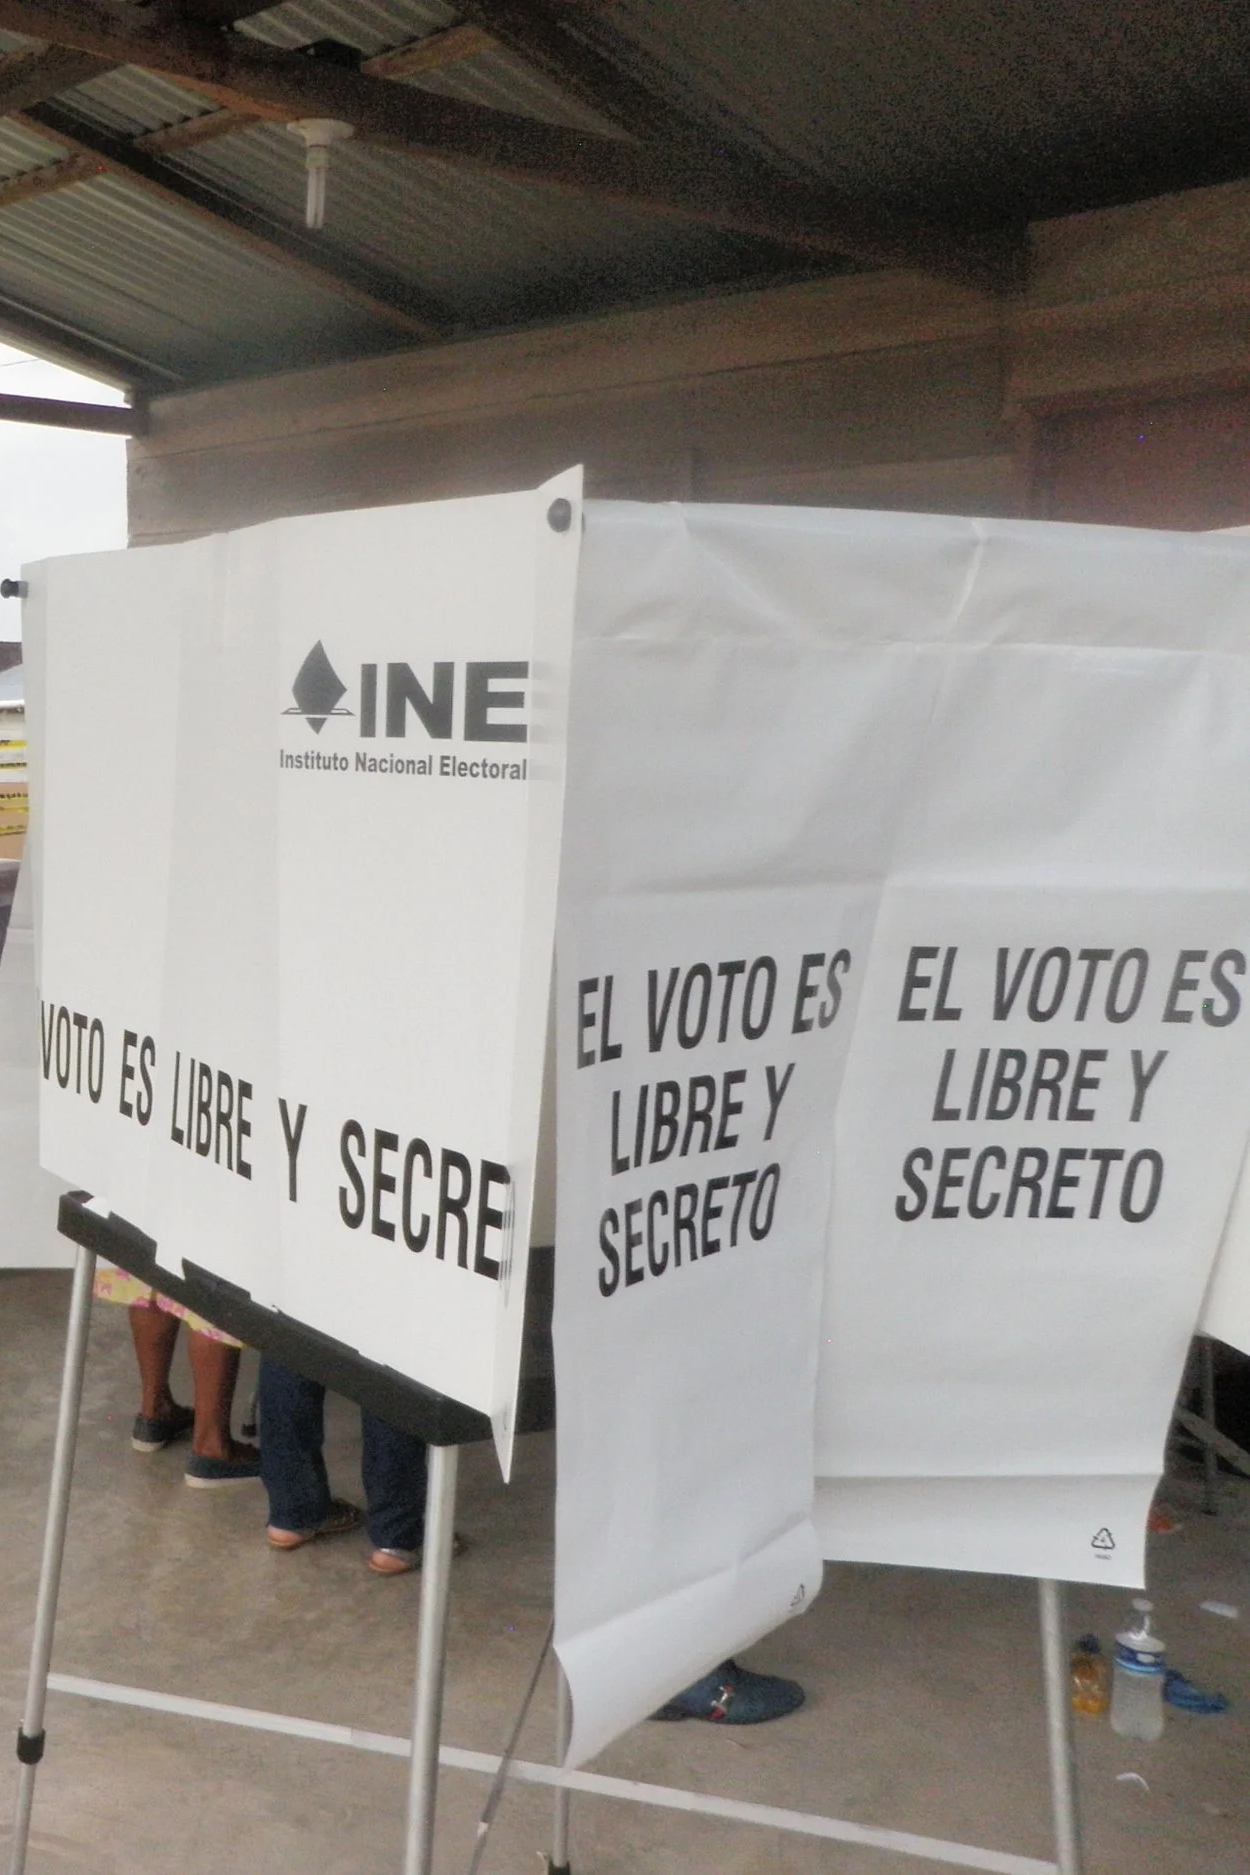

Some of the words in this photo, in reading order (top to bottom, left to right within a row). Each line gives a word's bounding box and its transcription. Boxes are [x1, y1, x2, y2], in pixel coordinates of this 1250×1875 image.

[360, 661, 529, 743] INE
[279, 749, 349, 771] Instituto
[355, 752, 432, 776] Nacional
[439, 755, 527, 780] Electoral
[577, 974, 623, 1070] EL
[647, 955, 778, 1053] VOTO
[791, 948, 851, 1034] ES
[897, 946, 963, 1022] EL
[992, 946, 1149, 1024] VOTO
[1161, 948, 1247, 1028] ES
[611, 1068, 747, 1177] LIBRE
[763, 1062, 796, 1142] Y
[931, 1048, 1109, 1122] LIBRE
[1128, 1049, 1169, 1123] Y
[40, 1000, 105, 1103] VOTO
[119, 1029, 156, 1126] ES
[170, 1051, 253, 1181] LIBRE
[278, 1097, 308, 1203] Y
[339, 1119, 511, 1282] SECRE
[895, 1145, 1164, 1224] SECRETO
[598, 1162, 781, 1298] SECRETO
